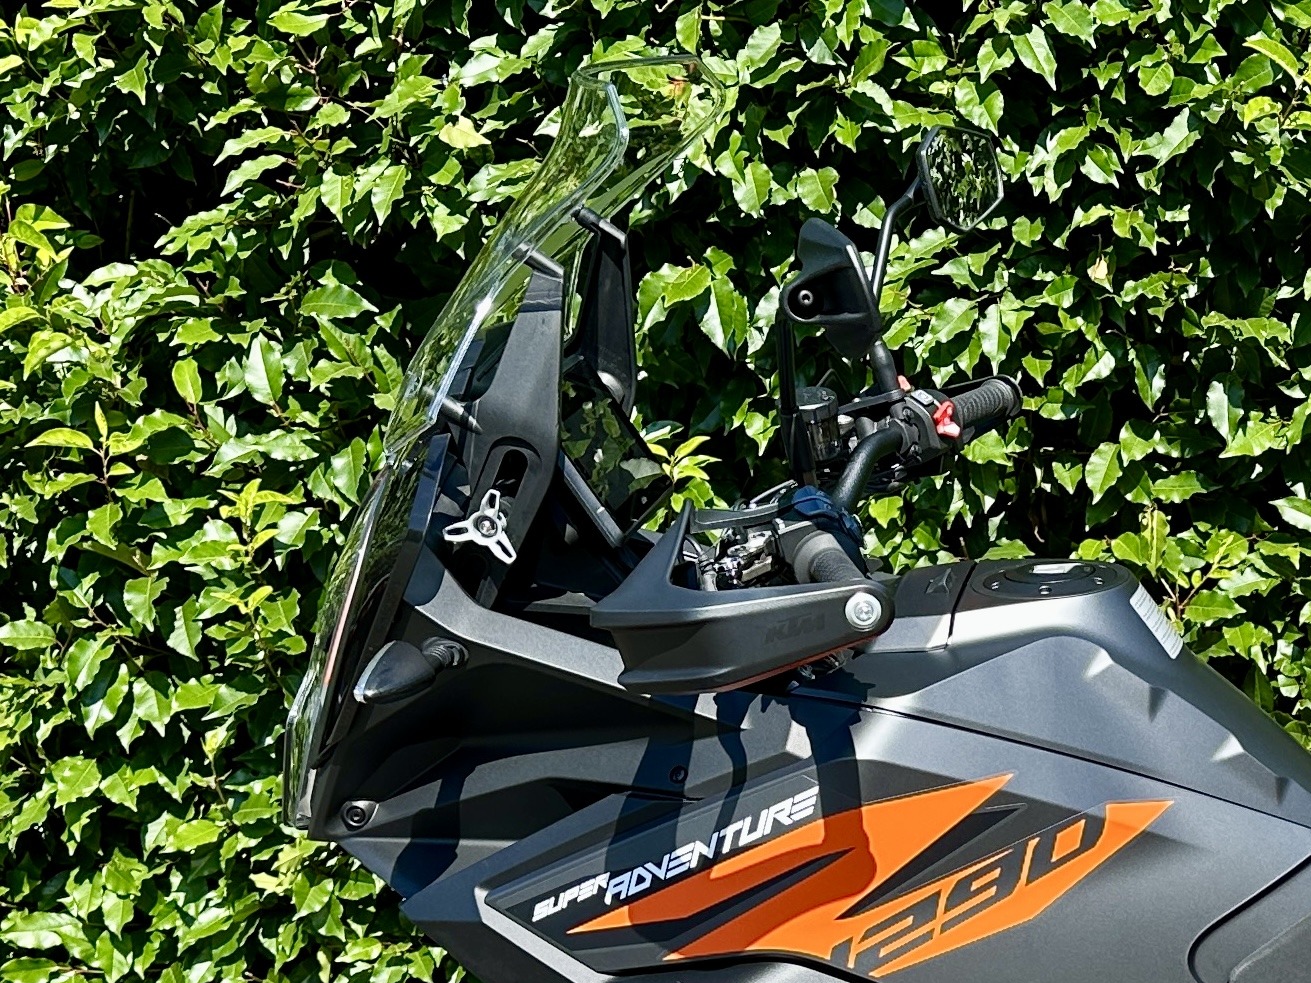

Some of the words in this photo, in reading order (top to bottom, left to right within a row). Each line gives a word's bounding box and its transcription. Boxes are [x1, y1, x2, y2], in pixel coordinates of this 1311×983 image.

[532, 872, 610, 922] SUPER
[604, 785, 820, 905] ADVENTURE
[829, 815, 1107, 977] 1290
